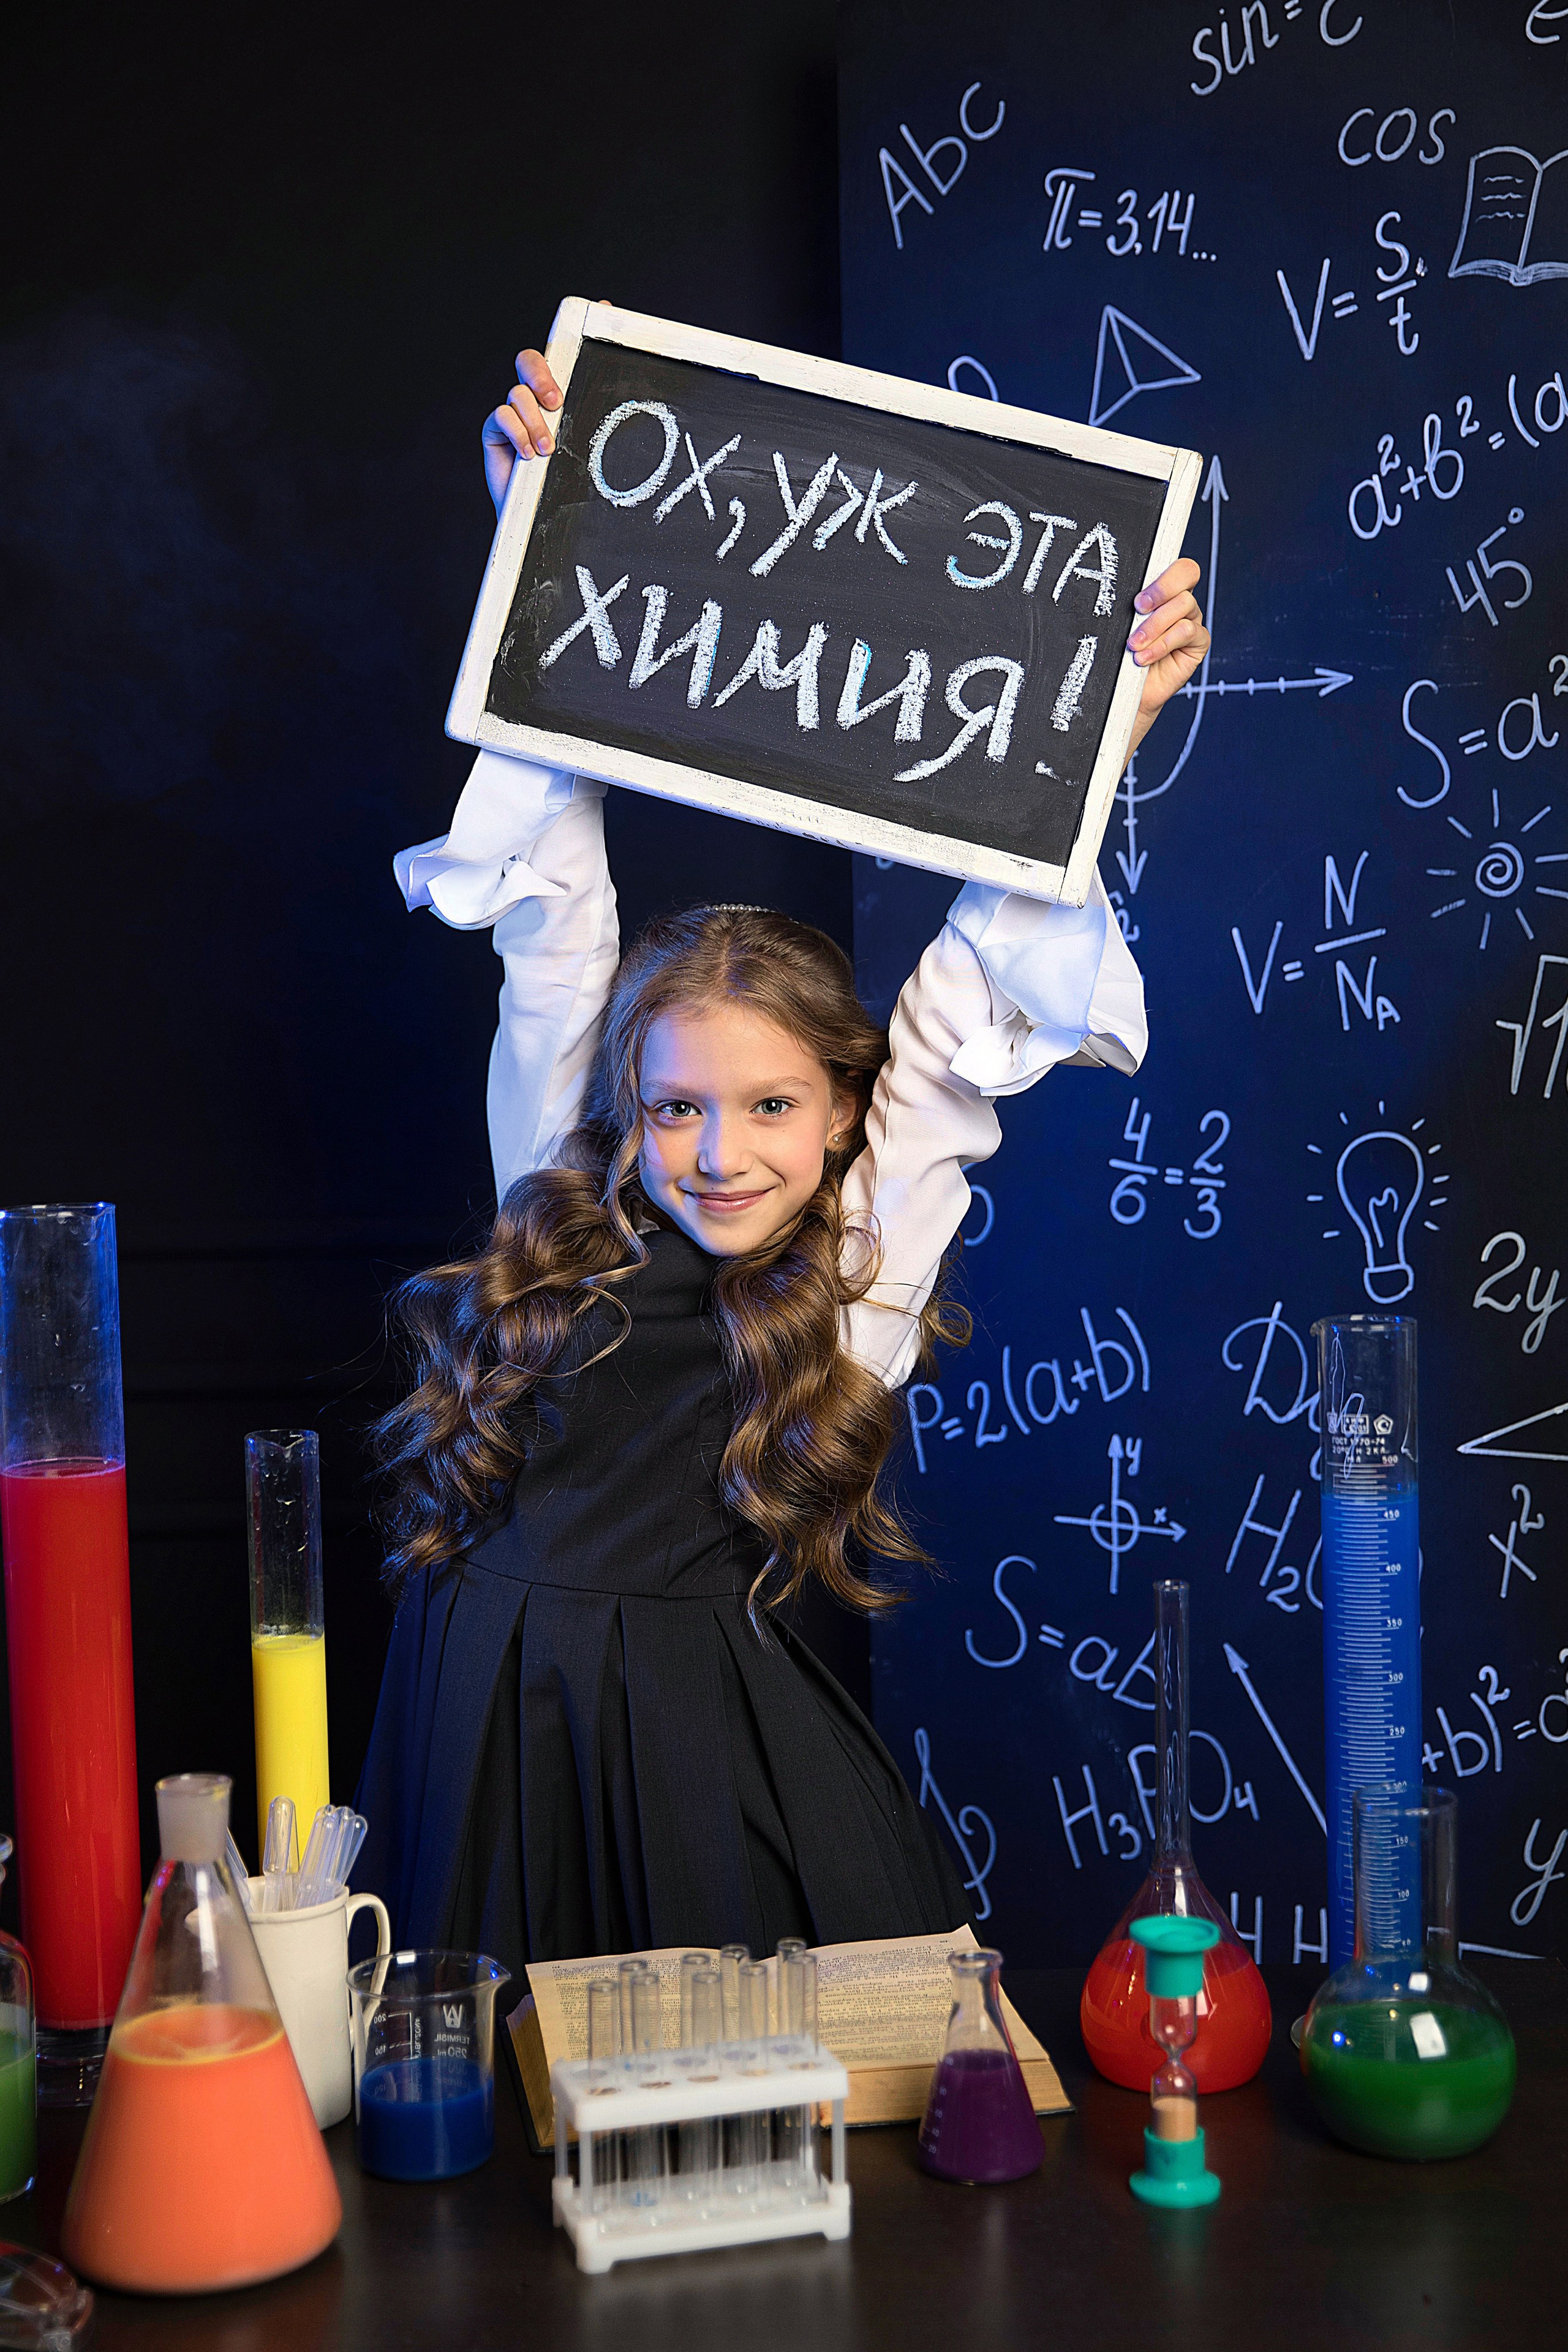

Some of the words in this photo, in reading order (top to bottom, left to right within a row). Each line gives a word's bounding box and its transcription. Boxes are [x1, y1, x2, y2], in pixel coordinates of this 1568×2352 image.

[1382, 1455, 1399, 1464] 500
[1384, 1509, 1400, 1519] 450
[1385, 1563, 1401, 1573] 400
[1387, 1618, 1403, 1627] 350
[1389, 1672, 1404, 1682] 300
[1390, 1726, 1405, 1736] 250
